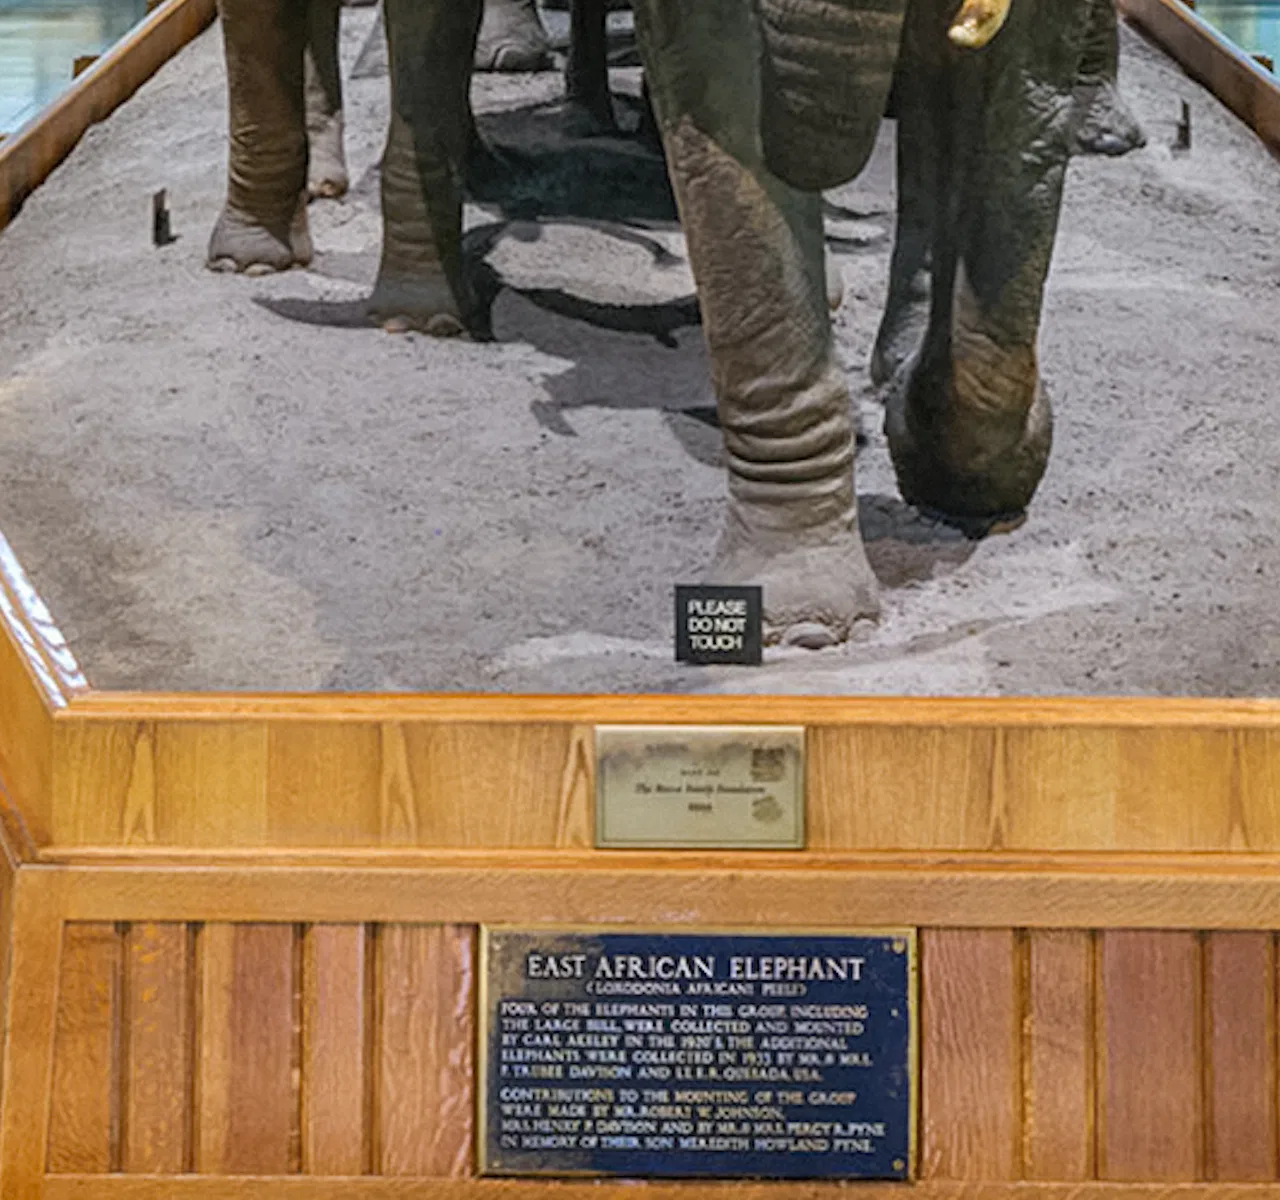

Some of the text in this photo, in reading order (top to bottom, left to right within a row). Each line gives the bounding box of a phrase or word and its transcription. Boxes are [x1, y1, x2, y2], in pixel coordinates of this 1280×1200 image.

[687, 600, 747, 615] PLEASE
[688, 618, 746, 632] DO NOT
[689, 635, 742, 650] TOUCH
[528, 955, 864, 981] EAST AFRICAN ELEPHANT
[541, 1002, 559, 1016] OF
[563, 1003, 590, 1016] THE
[595, 1003, 675, 1016] ELEPHANTS
[679, 1005, 698, 1017] IN
[502, 1019, 528, 1030] THE
[534, 1019, 580, 1030] LARGE
[622, 1019, 663, 1032] WERE
[670, 1020, 751, 1032] COLLECTED
[755, 1021, 788, 1033] AND
[793, 1022, 864, 1035] MOUNTED
[502, 1034, 519, 1045] BY
[624, 1035, 643, 1047] IN
[648, 1036, 675, 1047] THE
[632, 1051, 714, 1064] COLLECTED
[637, 1067, 671, 1079] AND
[642, 1090, 669, 1103] THE
[754, 1091, 772, 1104] OF
[660, 1122, 694, 1134] AND
[579, 1136, 598, 1148] OF
